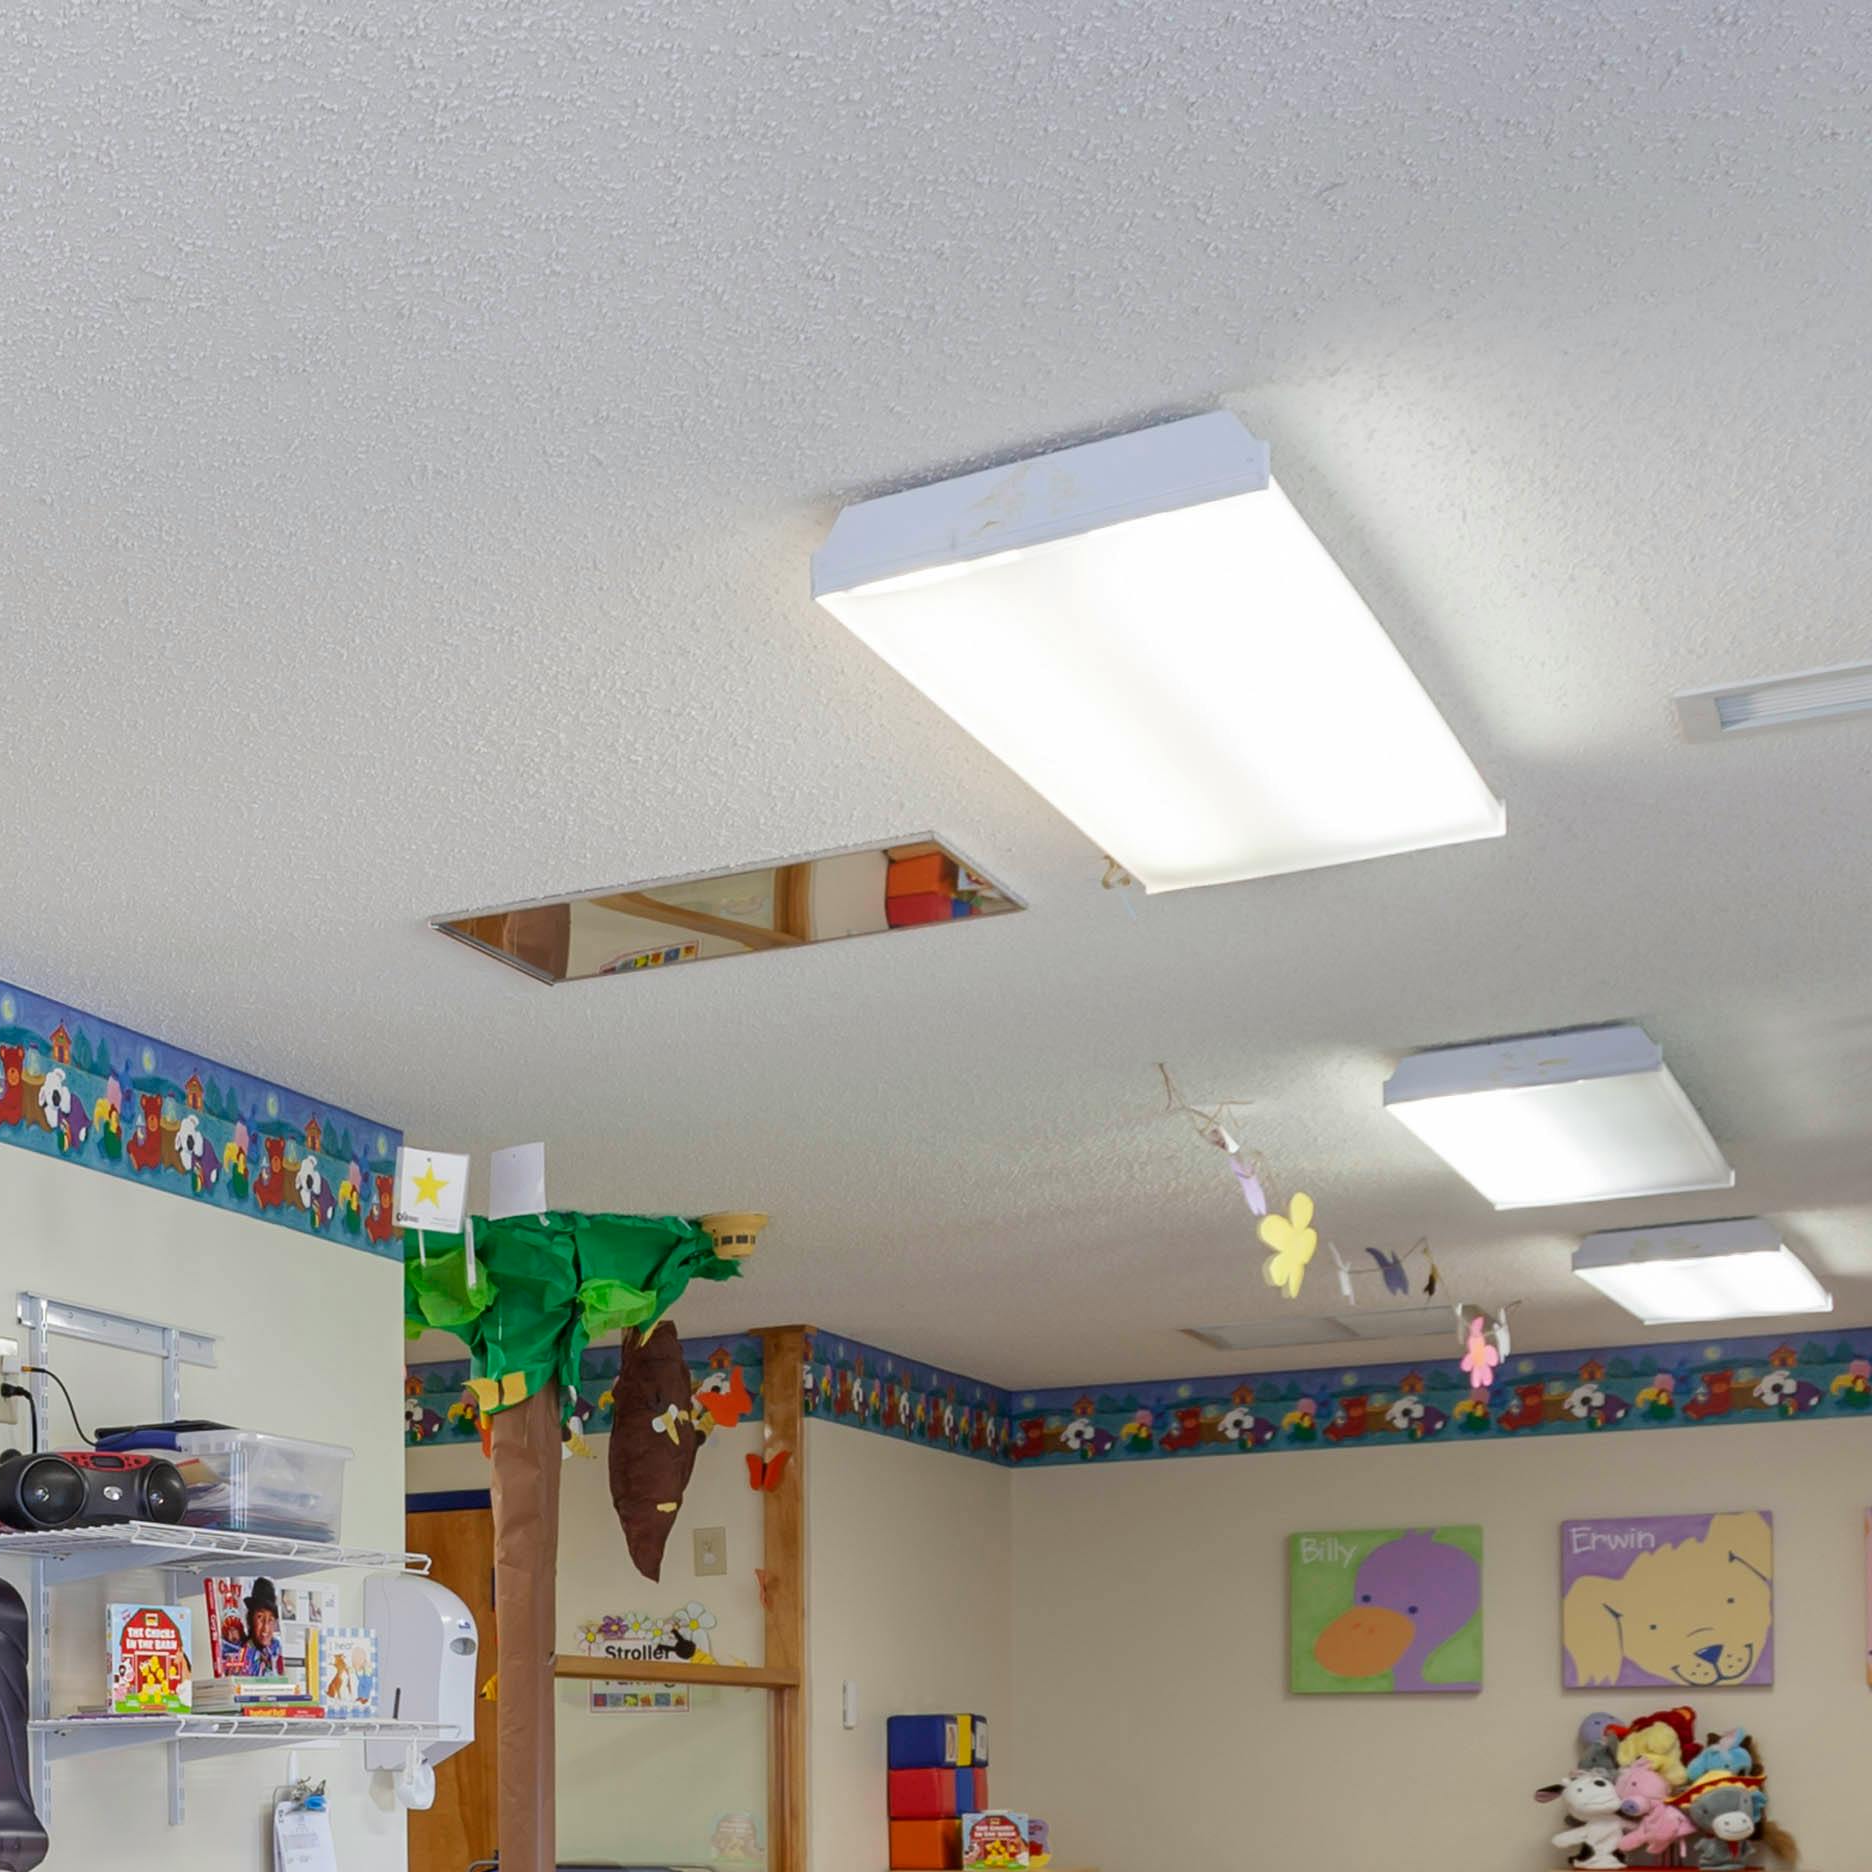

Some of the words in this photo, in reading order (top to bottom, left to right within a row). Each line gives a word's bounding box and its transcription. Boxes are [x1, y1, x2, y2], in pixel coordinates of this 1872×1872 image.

[1301, 1536, 1360, 1568] Billy
[1568, 1527, 1656, 1553] Erwin
[605, 1644, 670, 1661] Stroller
